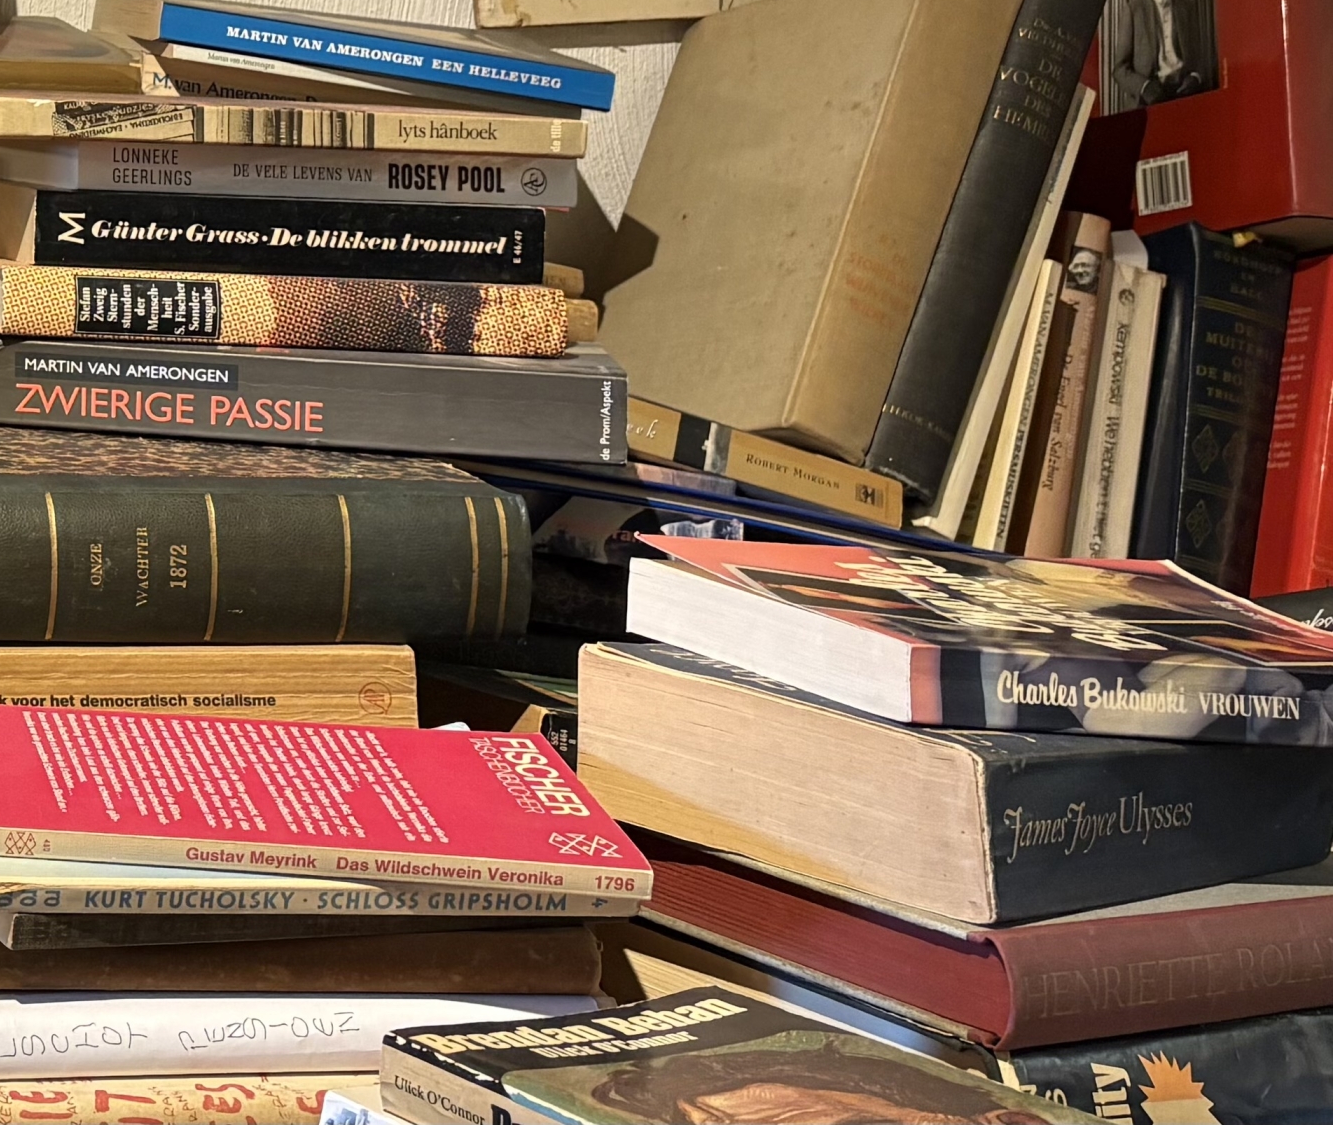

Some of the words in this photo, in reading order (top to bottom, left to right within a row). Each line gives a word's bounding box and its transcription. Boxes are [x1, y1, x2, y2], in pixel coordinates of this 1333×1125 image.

[227, 26, 287, 47] MARTIN
[293, 37, 324, 51] VAN
[328, 41, 423, 66] AMERONGEN
[432, 58, 463, 73] EEN
[468, 64, 562, 90] HELLEVEEG
[399, 121, 425, 141] lyts
[430, 121, 497, 140] hânboek
[112, 169, 192, 186] GEERLINGS
[113, 147, 179, 164] LONNEKE
[233, 165, 250, 178] DE
[255, 165, 287, 179] VELE
[293, 166, 342, 182] LEVENS
[347, 167, 372, 182] VAN
[388, 165, 449, 191] ROSEY
[457, 167, 505, 193] POOL
[92, 220, 184, 241] Günter
[269, 226, 303, 246] De
[306, 228, 398, 250] blikken
[403, 230, 506, 255] trommel
[24, 357, 83, 375] MARTIN
[88, 359, 120, 376] VAN
[125, 362, 229, 382] AMERONGEN
[15, 384, 195, 424] ZWIERIGE
[210, 397, 323, 432] PASSIE
[89, 543, 103, 585] ONZE
[135, 526, 148, 607] WACHTER
[170, 544, 188, 589] 1872
[996, 671, 1077, 707] Charles
[1084, 676, 1186, 715] Bukowski
[1199, 692, 1300, 720] VROUWEN
[491, 736, 589, 816] FISCHER
[1004, 808, 1068, 862] James
[1068, 807, 1115, 854] Joyce
[1118, 792, 1193, 844] Ulysses
[186, 847, 245, 865] Gustav
[250, 850, 317, 871] Meyrink
[336, 856, 366, 872] Das
[375, 860, 483, 883] Wildschwein
[488, 867, 563, 886] Veronika
[594, 875, 635, 891] 1796
